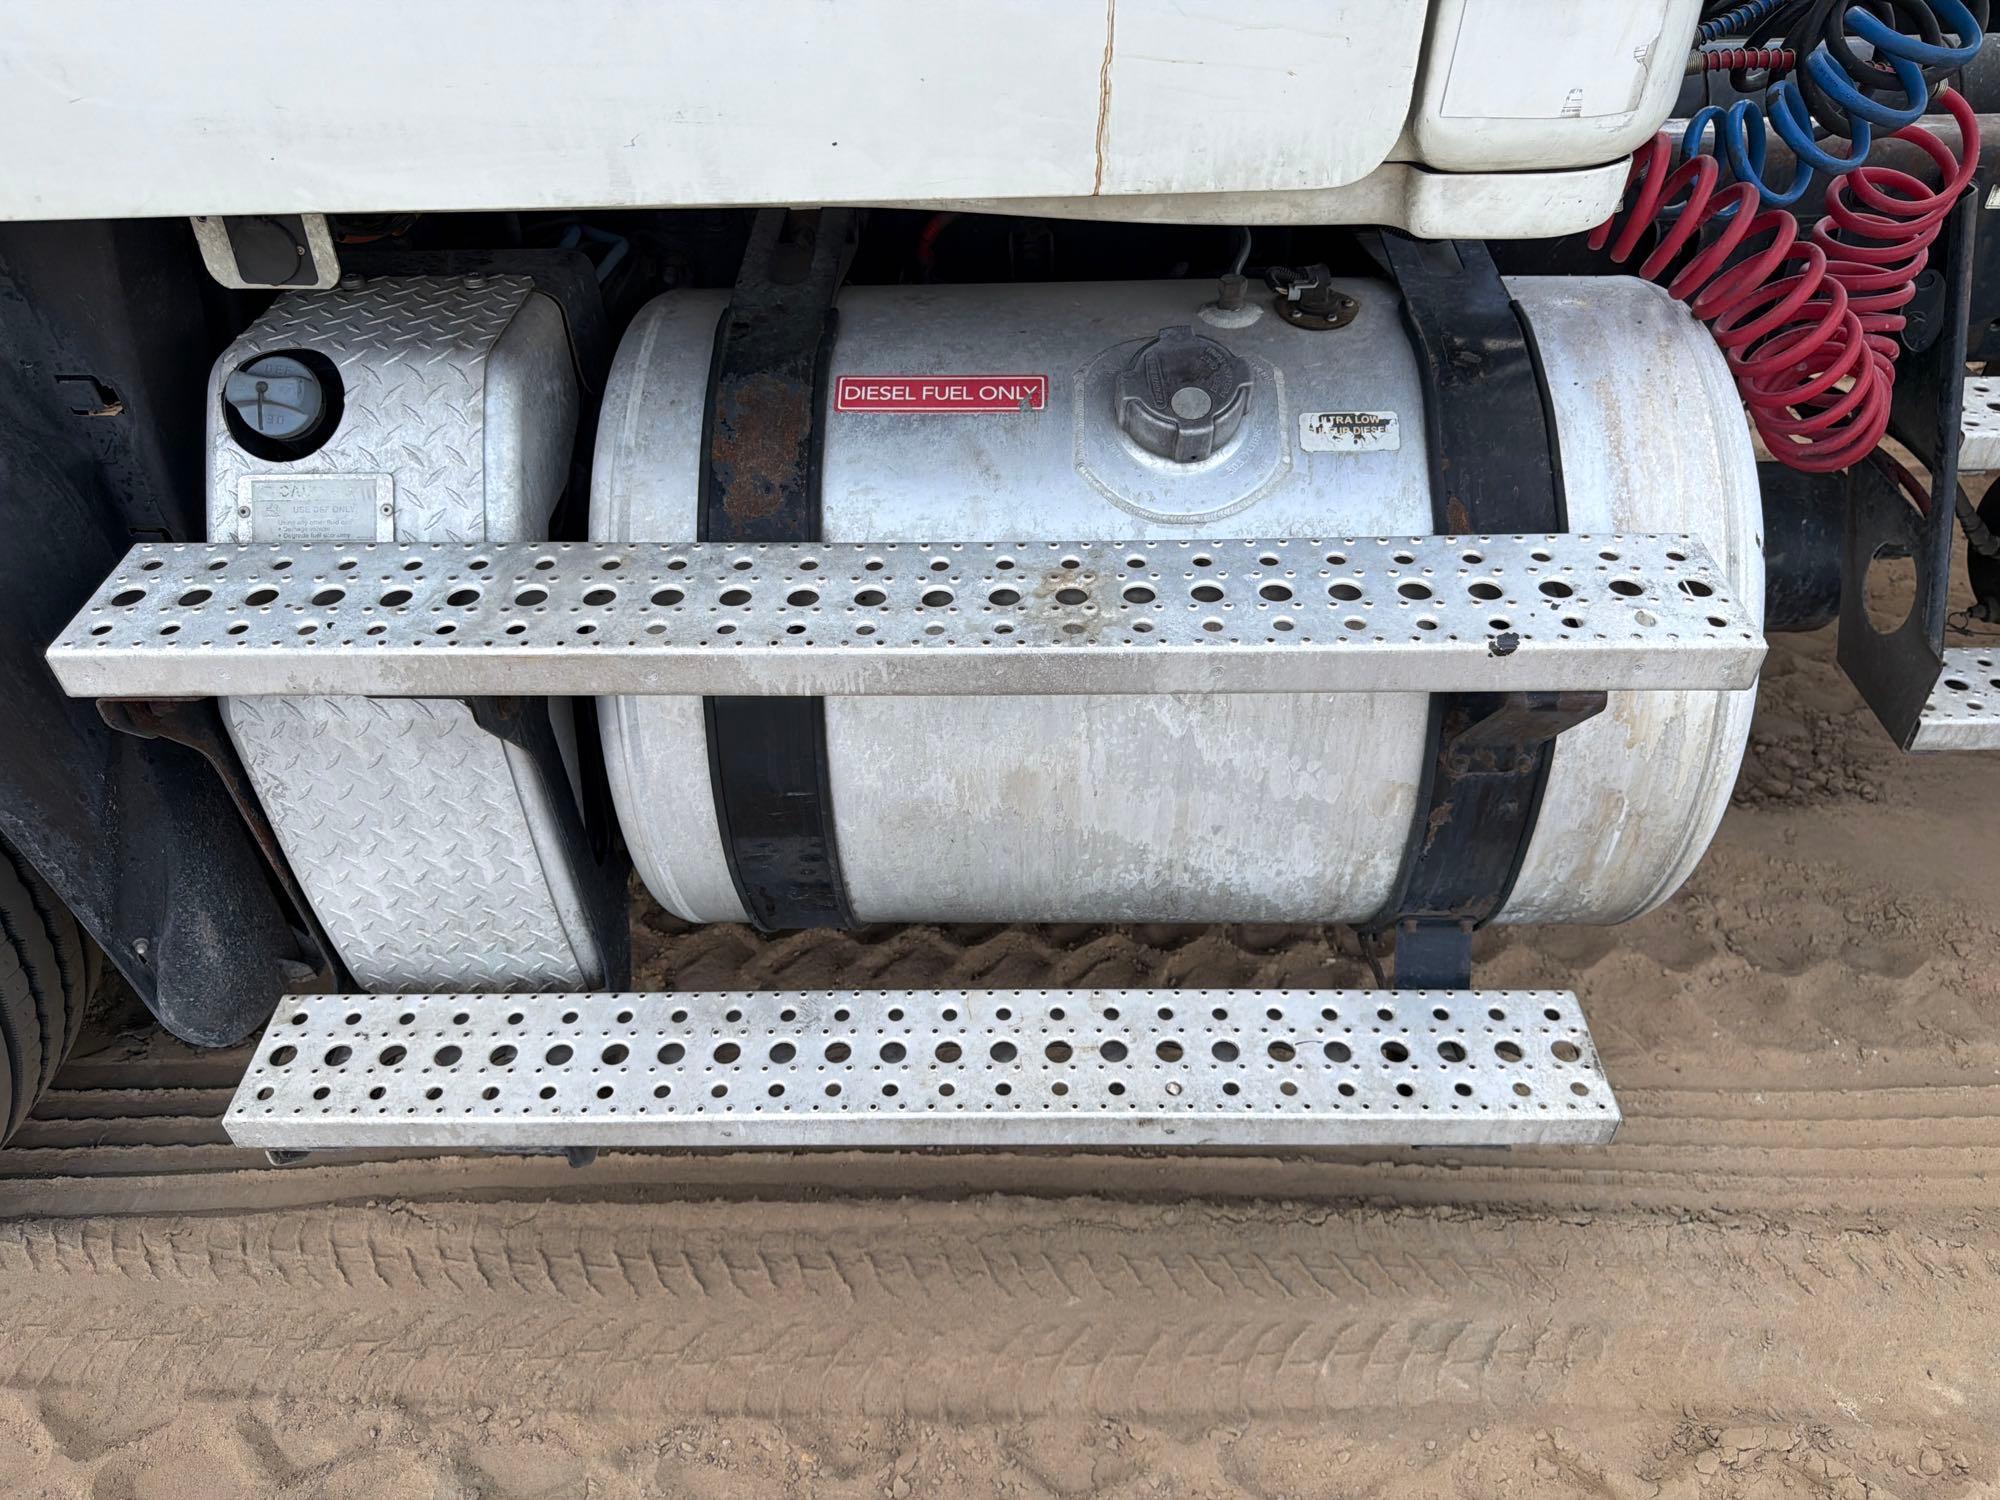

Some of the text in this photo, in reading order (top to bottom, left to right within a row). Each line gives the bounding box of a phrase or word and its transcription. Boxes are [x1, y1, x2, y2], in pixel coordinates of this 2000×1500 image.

[844, 385, 1038, 401] DIESEL FUEL ONLY
[1354, 415, 1380, 425] LOW
[1353, 426, 1388, 435] DIESE
